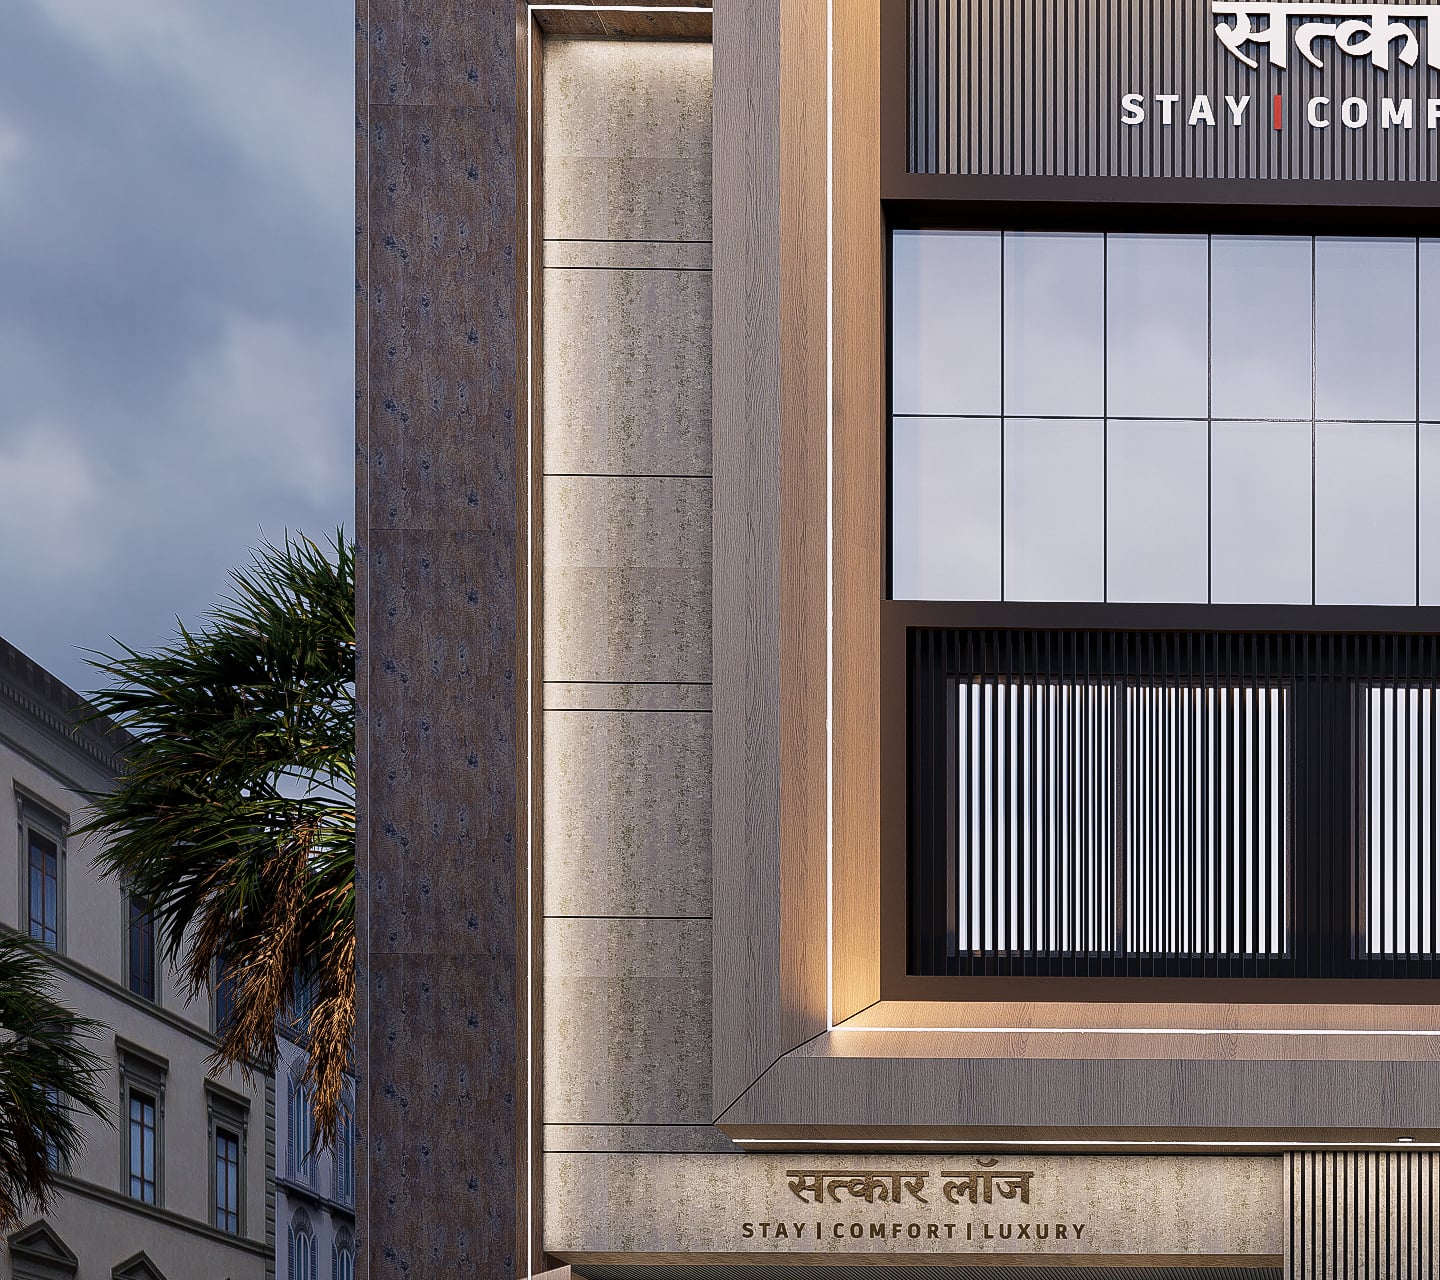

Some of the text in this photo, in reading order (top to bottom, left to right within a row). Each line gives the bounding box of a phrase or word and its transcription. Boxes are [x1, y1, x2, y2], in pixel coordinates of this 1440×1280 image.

[1120, 92, 1252, 128] STAY
[786, 1158, 1034, 1205] सत्कार लॉज
[742, 1222, 806, 1240] STAY
[832, 1222, 957, 1241] COMFORT
[984, 1223, 1086, 1241] LUXURY
